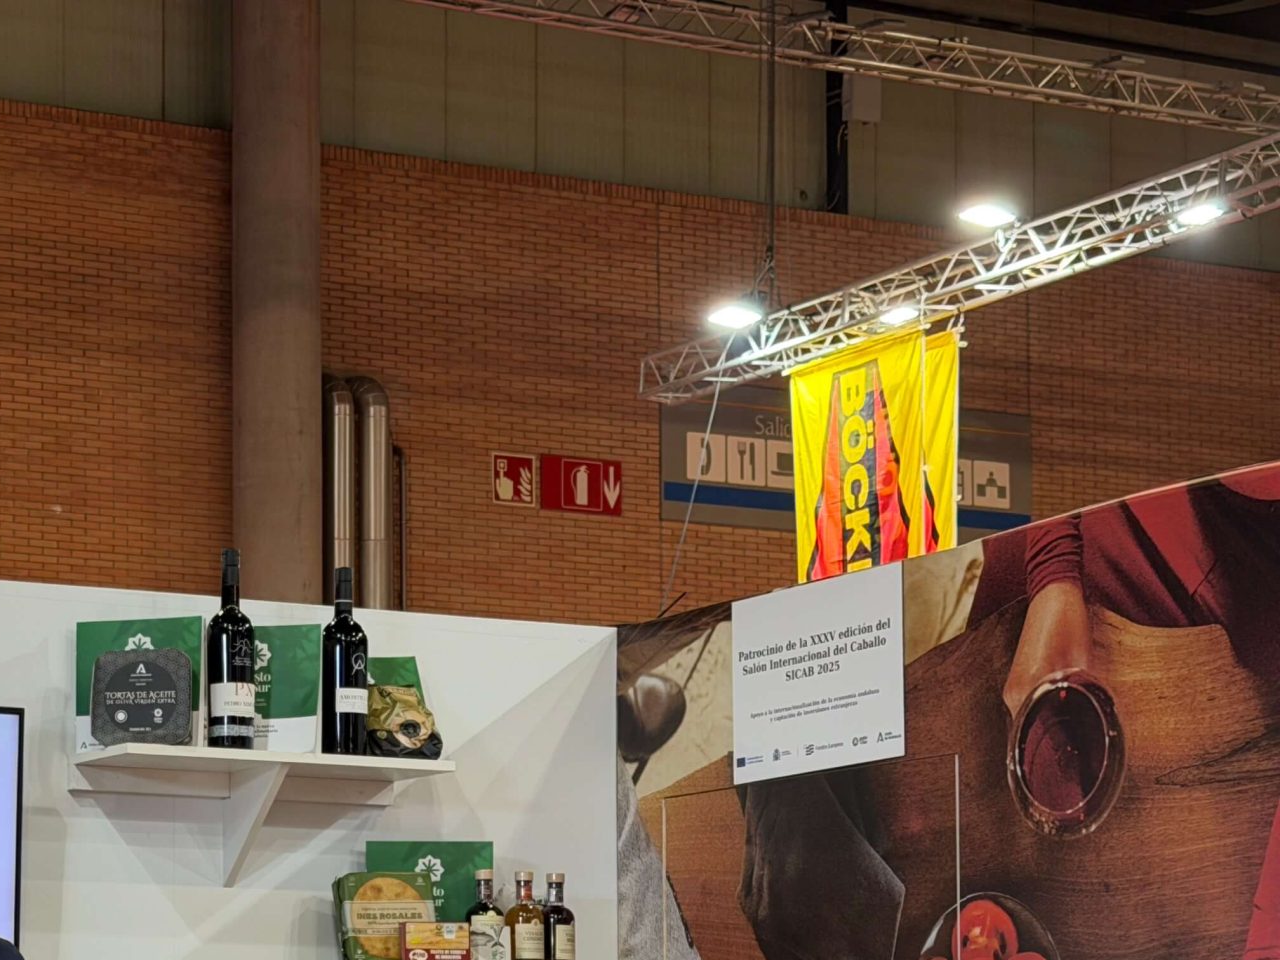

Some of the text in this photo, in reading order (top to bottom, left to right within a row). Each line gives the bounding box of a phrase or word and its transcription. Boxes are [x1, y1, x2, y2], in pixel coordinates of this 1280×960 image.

[738, 617, 891, 662] Patrocinio de la XXXV edición del
[742, 635, 887, 676] Salón Internacional del Caballo
[785, 660, 840, 681] SICAB 2025
[105, 690, 176, 700] TORTAS DE ACEITE
